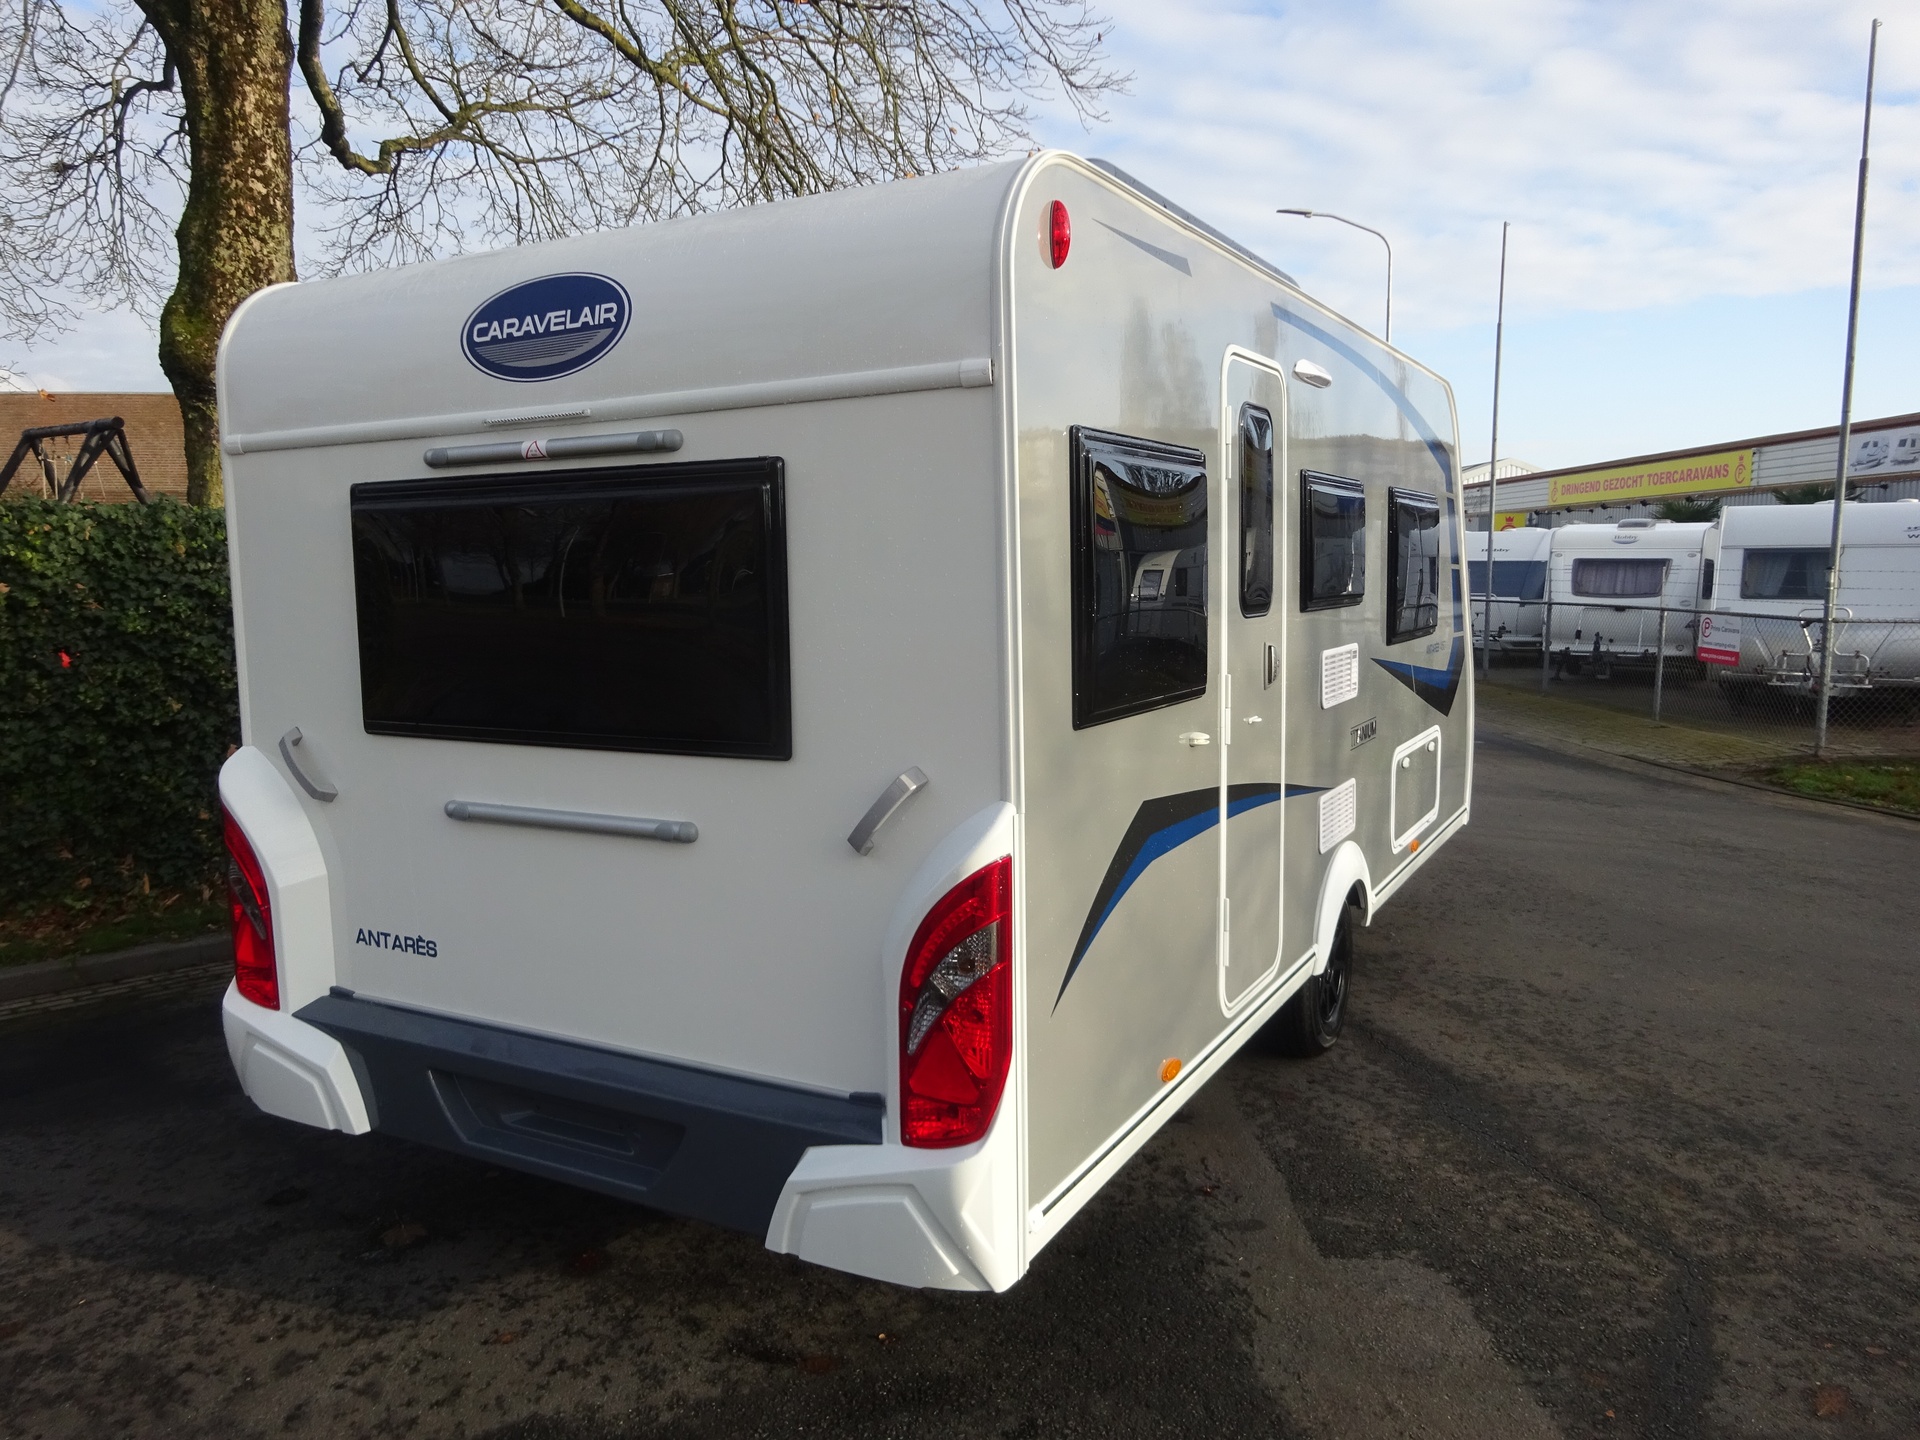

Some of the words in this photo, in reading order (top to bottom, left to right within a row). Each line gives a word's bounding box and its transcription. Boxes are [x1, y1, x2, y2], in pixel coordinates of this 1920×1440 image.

[473, 302, 618, 343] CARAVELAIR
[1560, 480, 1601, 496] DRINGEND
[1603, 474, 1645, 491] GEZOCHT
[1646, 463, 1729, 486] TOERCARAVANS
[1614, 534, 1638, 542] Hobby
[355, 927, 438, 958] ANTARÈS
